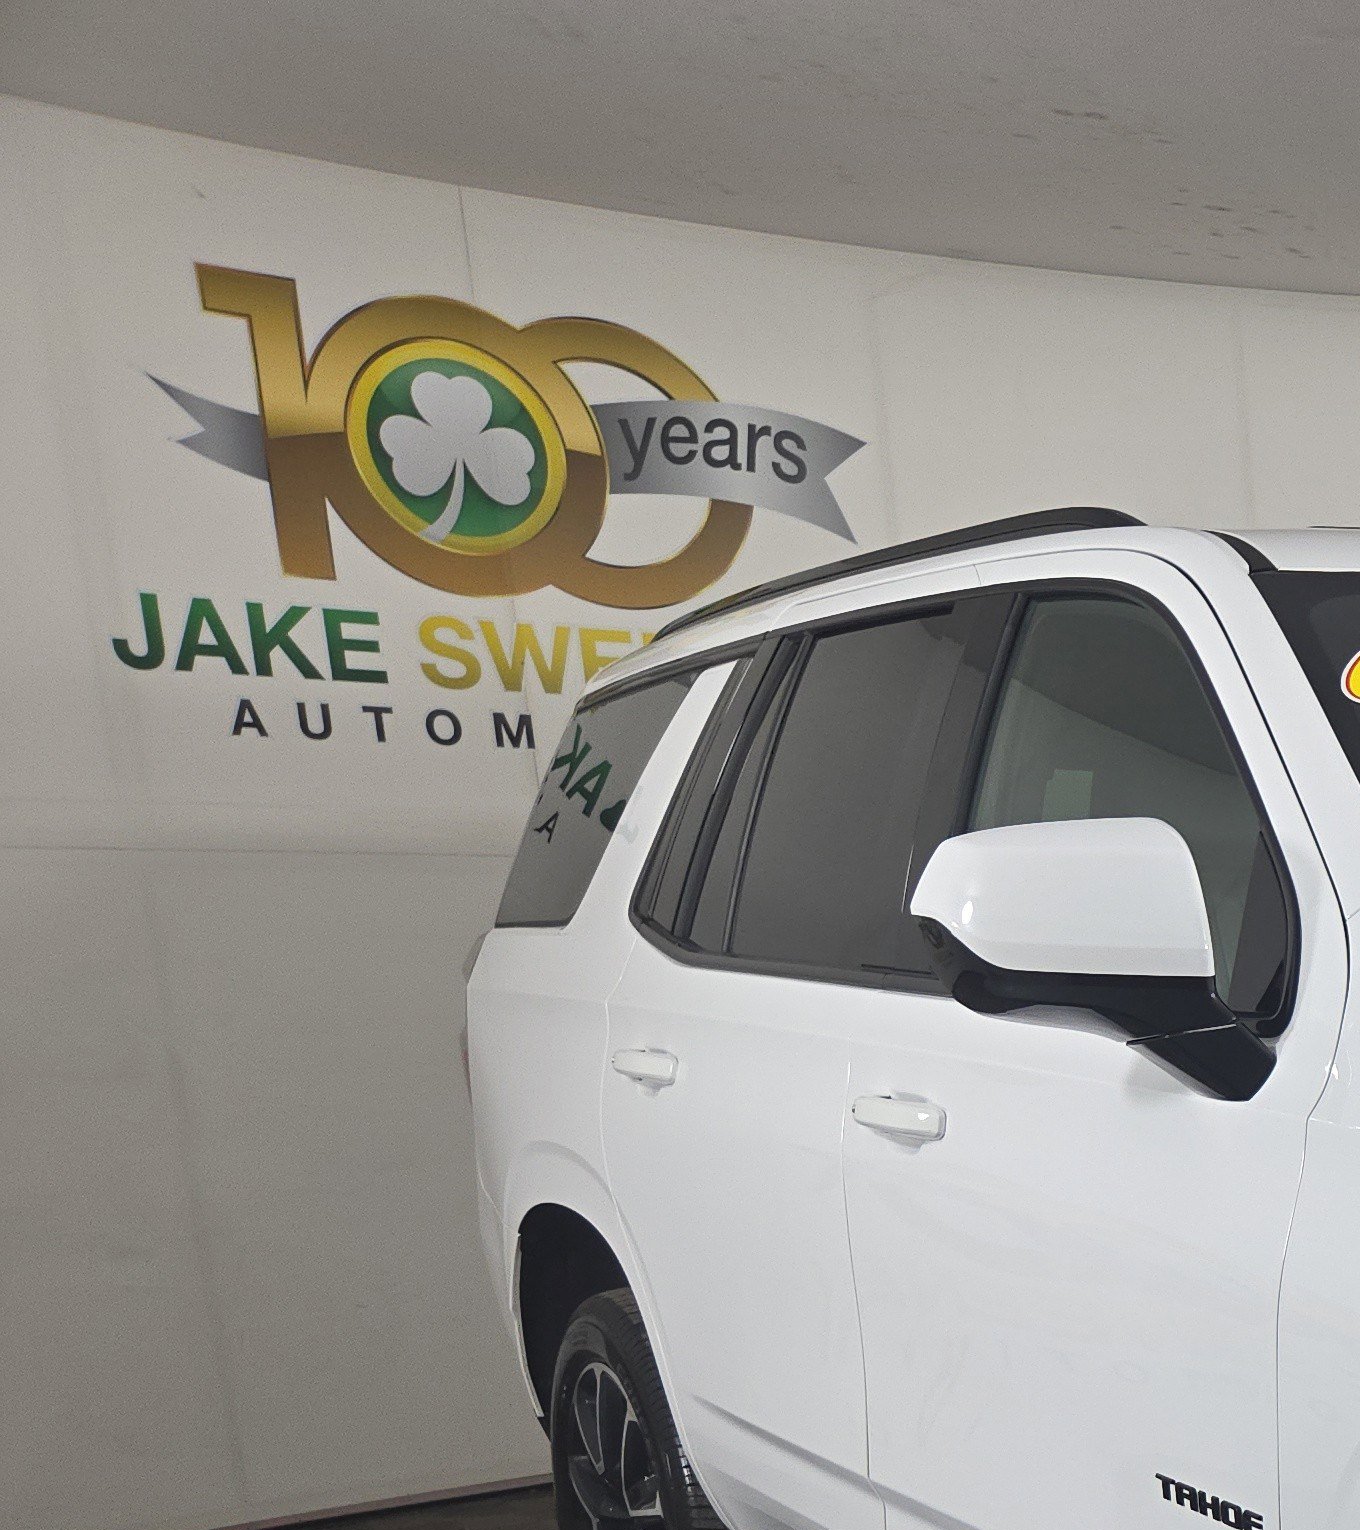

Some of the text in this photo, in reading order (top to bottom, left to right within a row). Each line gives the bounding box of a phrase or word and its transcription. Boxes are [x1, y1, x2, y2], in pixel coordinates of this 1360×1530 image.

[192, 262, 810, 610] 100 years
[112, 592, 656, 695] JAKE SWE
[232, 698, 536, 751] AUTOM
